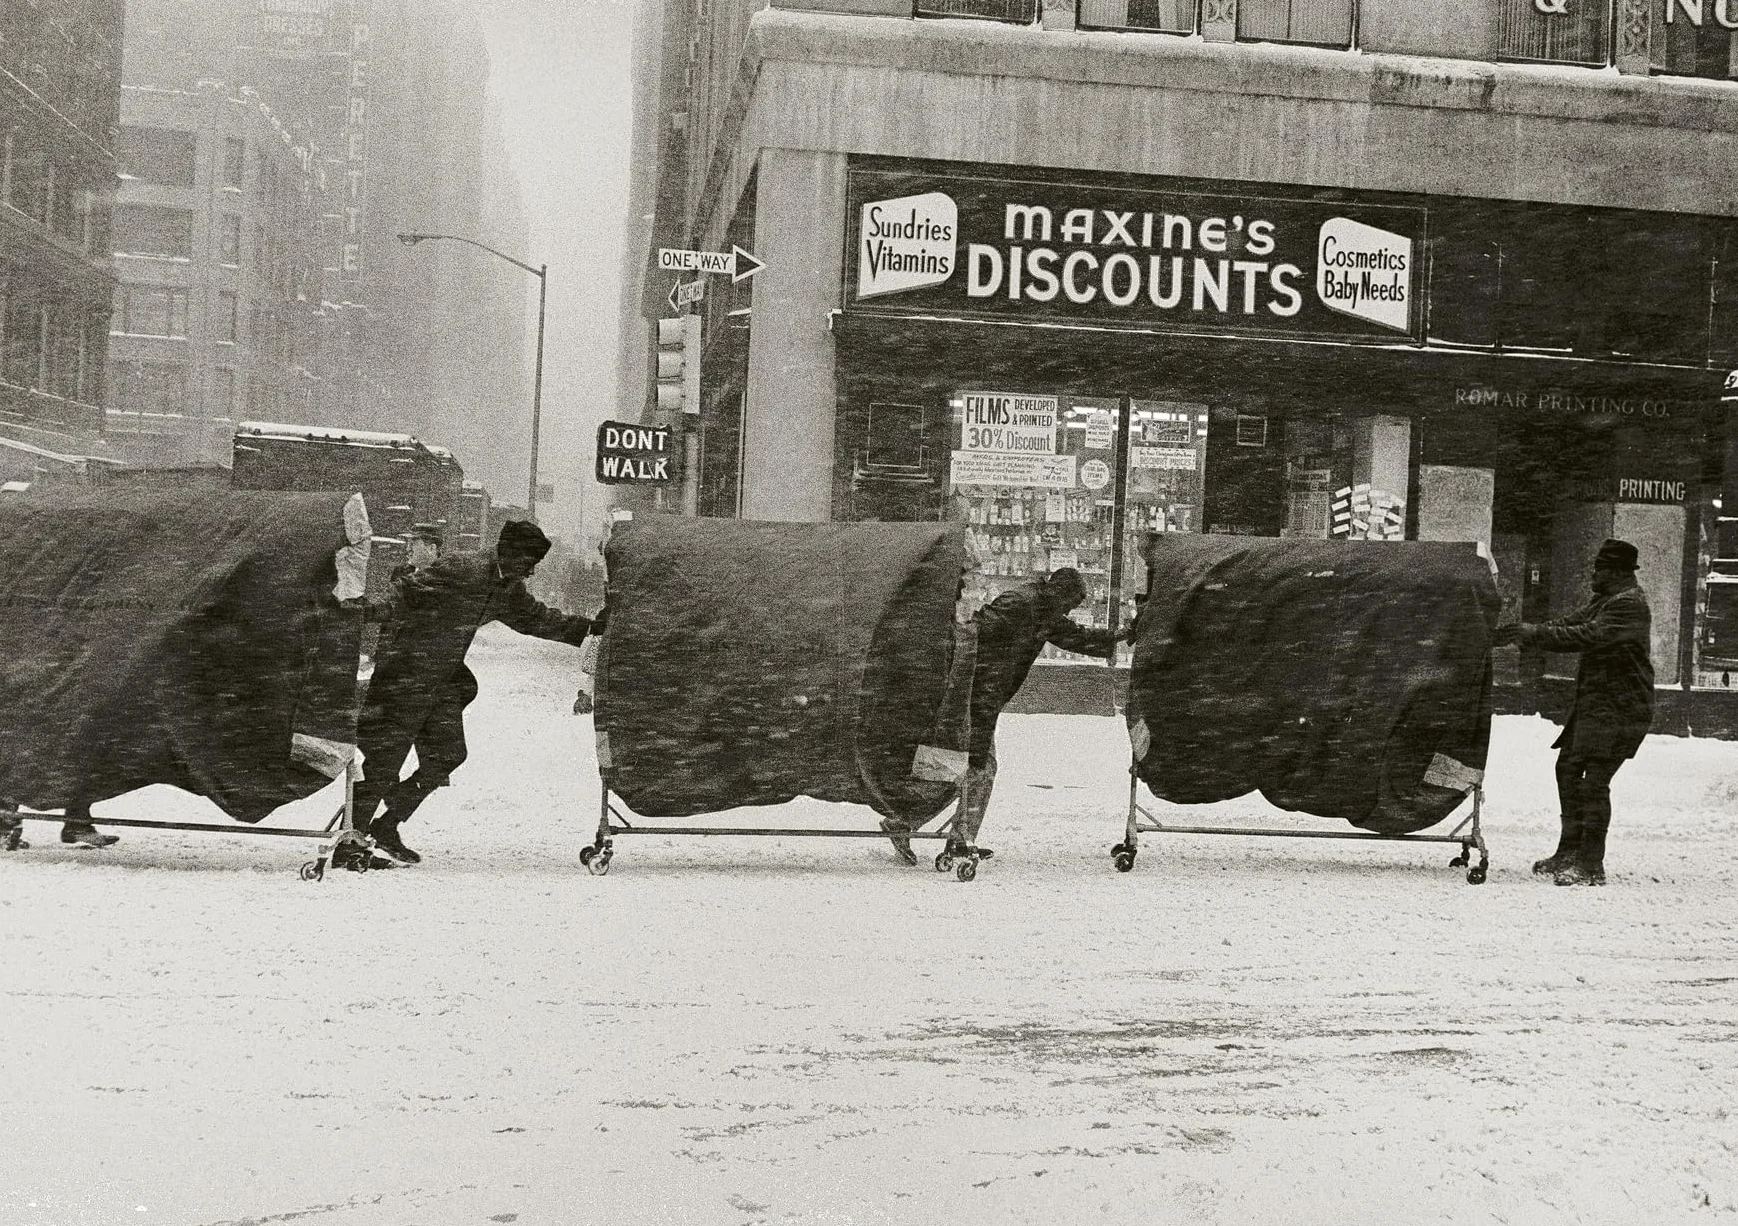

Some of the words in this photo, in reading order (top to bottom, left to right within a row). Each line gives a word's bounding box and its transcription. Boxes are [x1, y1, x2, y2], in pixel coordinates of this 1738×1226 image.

[869, 205, 952, 243] Sundries
[662, 251, 692, 268] ONE
[701, 254, 730, 270] WAY
[865, 239, 950, 282] Vitamins
[1322, 235, 1407, 271] Cosmetics
[967, 242, 1304, 317] DISCOUNTS
[1323, 269, 1361, 309] Baby
[1361, 270, 1405, 303] Needs
[966, 396, 1010, 425] FILMS
[1014, 398, 1055, 412] DEVELOPED
[1455, 388, 1528, 408] ROMAR
[1538, 394, 1635, 415] PRINTING
[1642, 400, 1671, 417] CO.
[1012, 414, 1018, 426] &
[1019, 414, 1053, 427] PRINTED
[605, 427, 668, 450] DONT
[967, 427, 1004, 449] 30%
[1006, 430, 1052, 451] Discount
[602, 457, 668, 480] WALK
[1619, 478, 1686, 501] PRINTING
